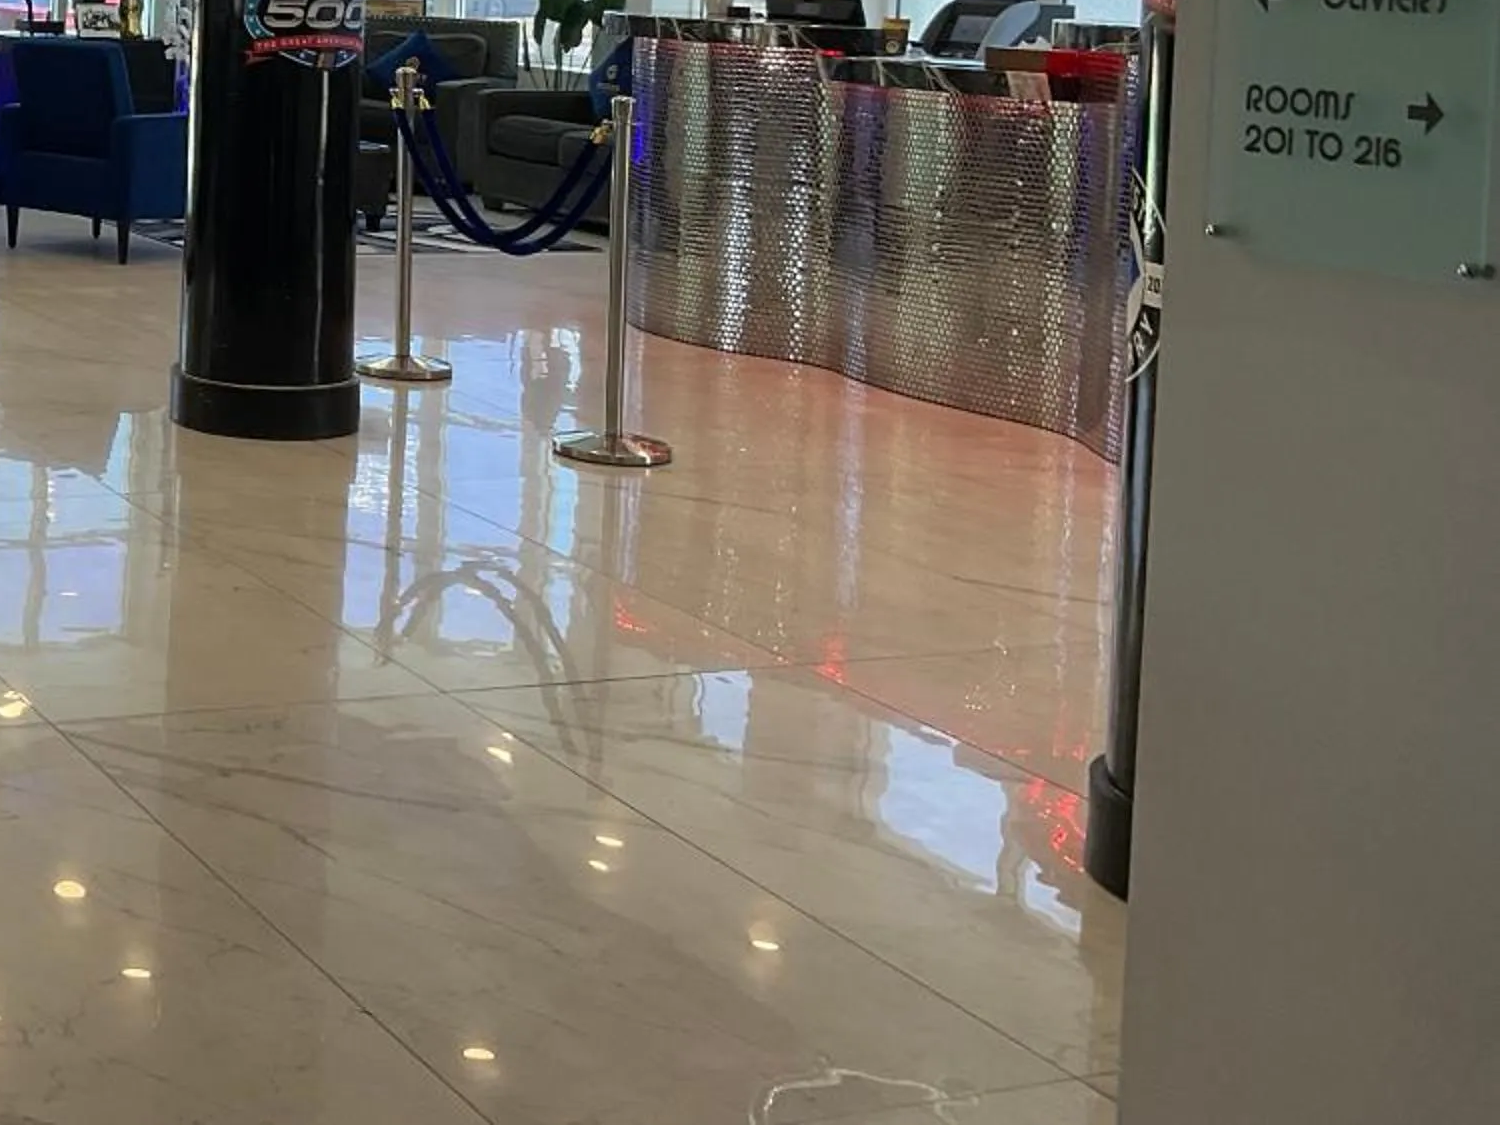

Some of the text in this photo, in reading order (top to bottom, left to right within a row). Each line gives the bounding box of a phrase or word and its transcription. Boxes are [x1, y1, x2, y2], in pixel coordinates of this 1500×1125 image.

[1245, 83, 1355, 121] ROOMS
[1243, 124, 1402, 168] 201 TO 216
